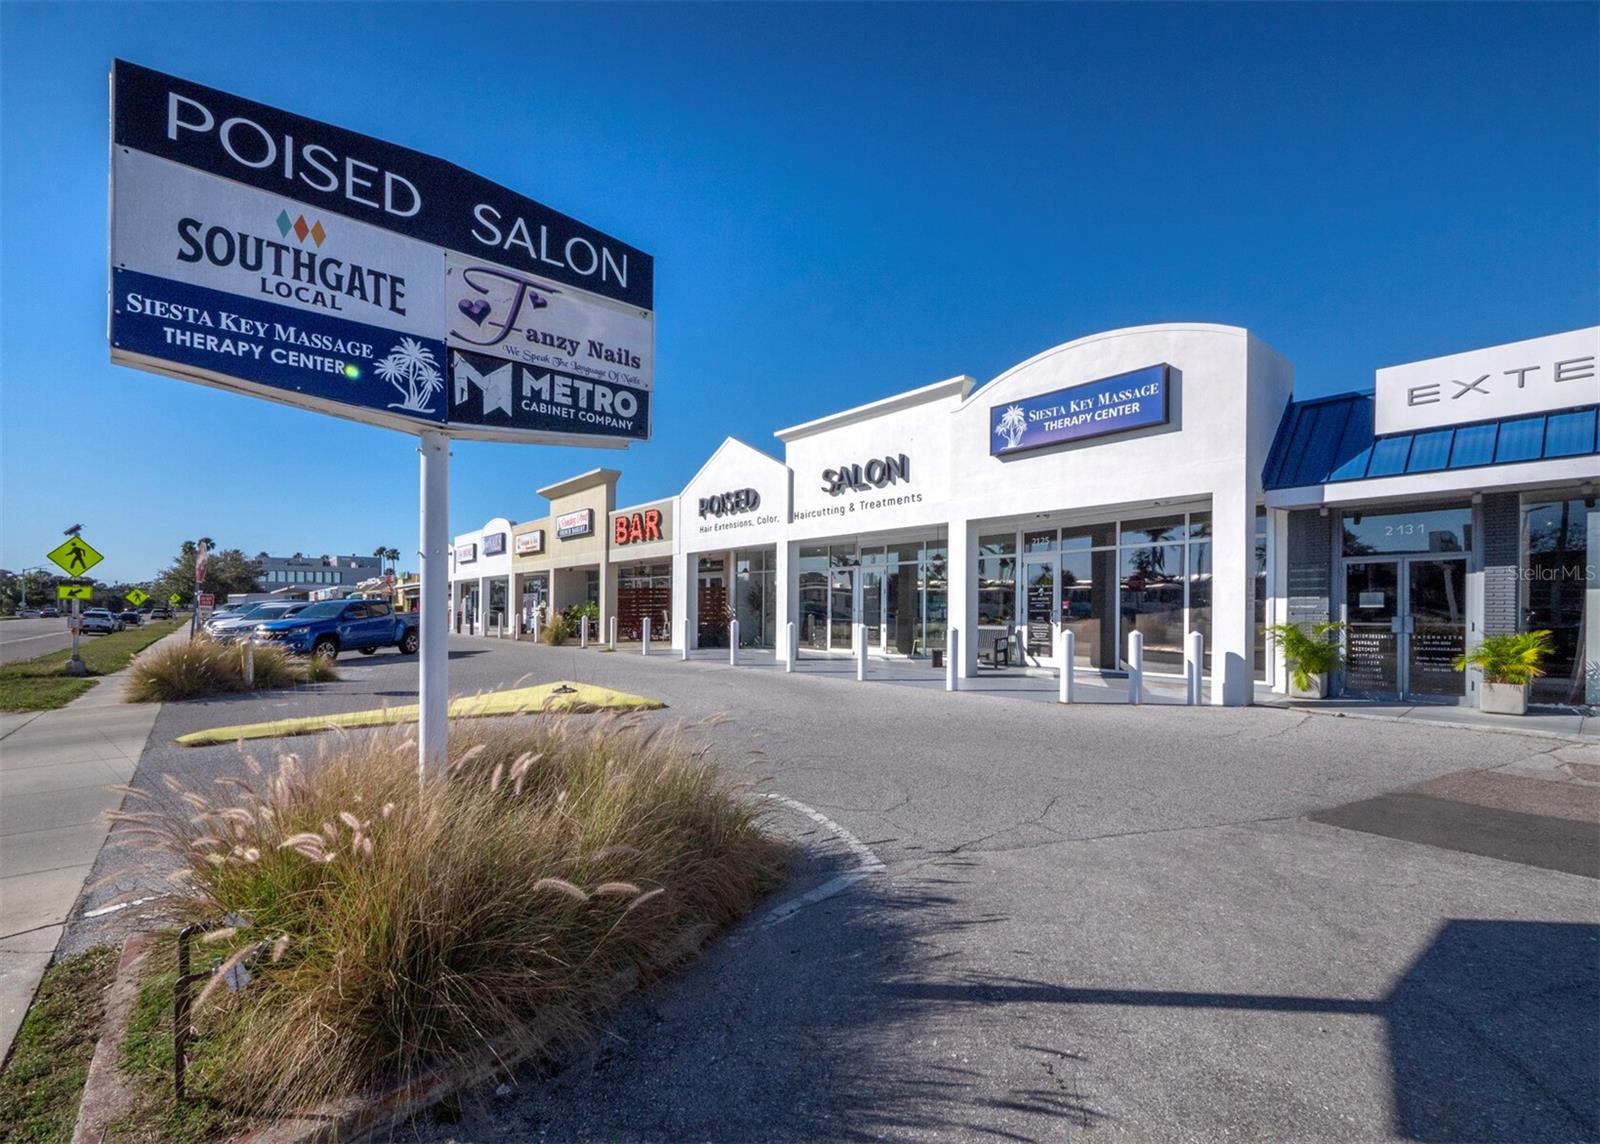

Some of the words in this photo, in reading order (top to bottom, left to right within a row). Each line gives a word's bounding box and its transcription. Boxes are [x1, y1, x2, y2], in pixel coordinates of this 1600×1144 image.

[168, 92, 421, 217] POISED
[471, 204, 627, 288] SALON
[176, 218, 406, 316] SOUTHGATE
[260, 277, 343, 311] LOCAL
[126, 293, 214, 327] SIESTA
[218, 310, 269, 338] KEY
[273, 323, 374, 358] MASSAGE
[163, 327, 264, 359] THERAPY
[271, 348, 346, 375] CENTER
[588, 339, 641, 369] Nails
[522, 367, 638, 418] METRO
[1407, 356, 1595, 406] EXTE
[521, 400, 575, 419] CABINET
[578, 411, 634, 430] COMPANY
[1029, 406, 1066, 422] SIESTA
[1070, 398, 1095, 413] KEY
[1098, 382, 1159, 406] MASSAGE
[1043, 412, 1093, 432] THERAPY
[1094, 402, 1140, 421] CENTER
[821, 453, 910, 497] SALON
[698, 487, 761, 520] POISED
[793, 505, 845, 521] Haircutting
[849, 503, 855, 513] &
[860, 492, 923, 510] Treatments
[615, 509, 662, 545] BAR
[699, 525, 713, 534] Hair
[1031, 536, 1050, 545] 2125
[1384, 524, 1424, 537] 2131
